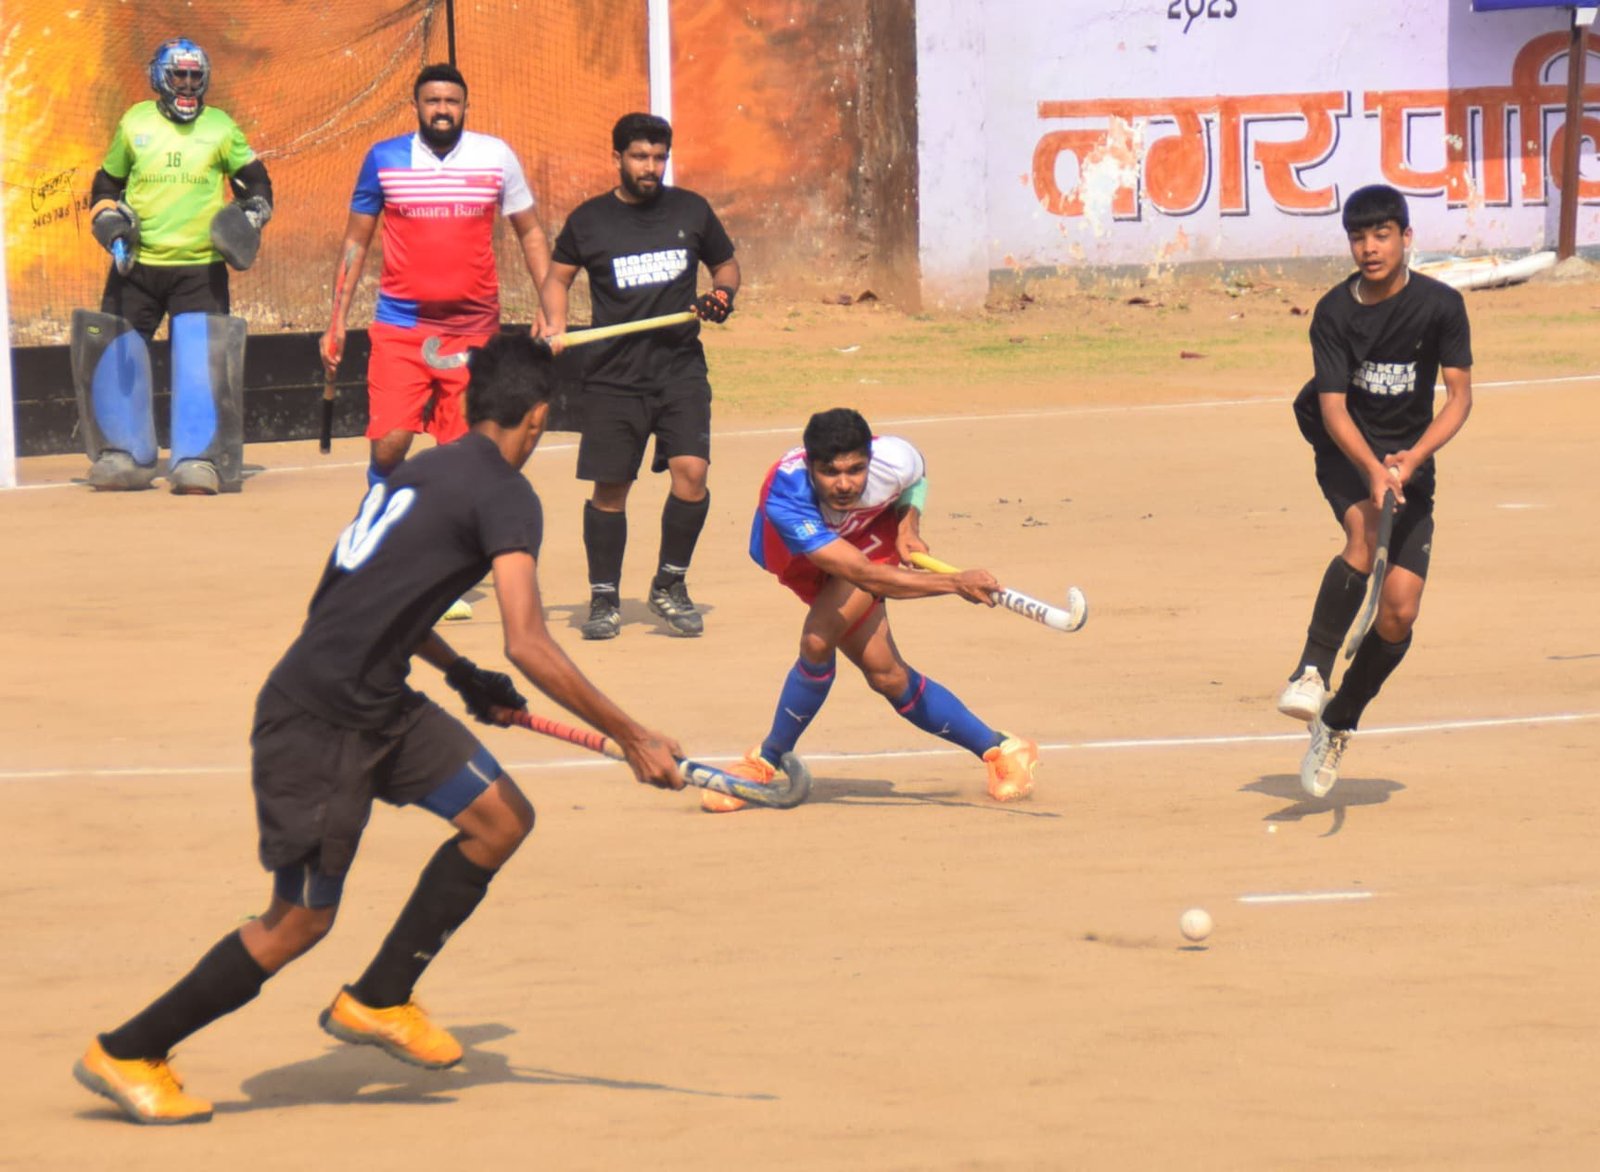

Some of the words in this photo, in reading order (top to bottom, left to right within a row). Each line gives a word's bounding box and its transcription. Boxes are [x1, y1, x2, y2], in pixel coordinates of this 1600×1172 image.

[165, 151, 182, 168] 16
[1032, 90, 1350, 220] नगर
[399, 203, 449, 218] Canara
[454, 202, 486, 218] Bank
[613, 249, 687, 267] HOCKEY
